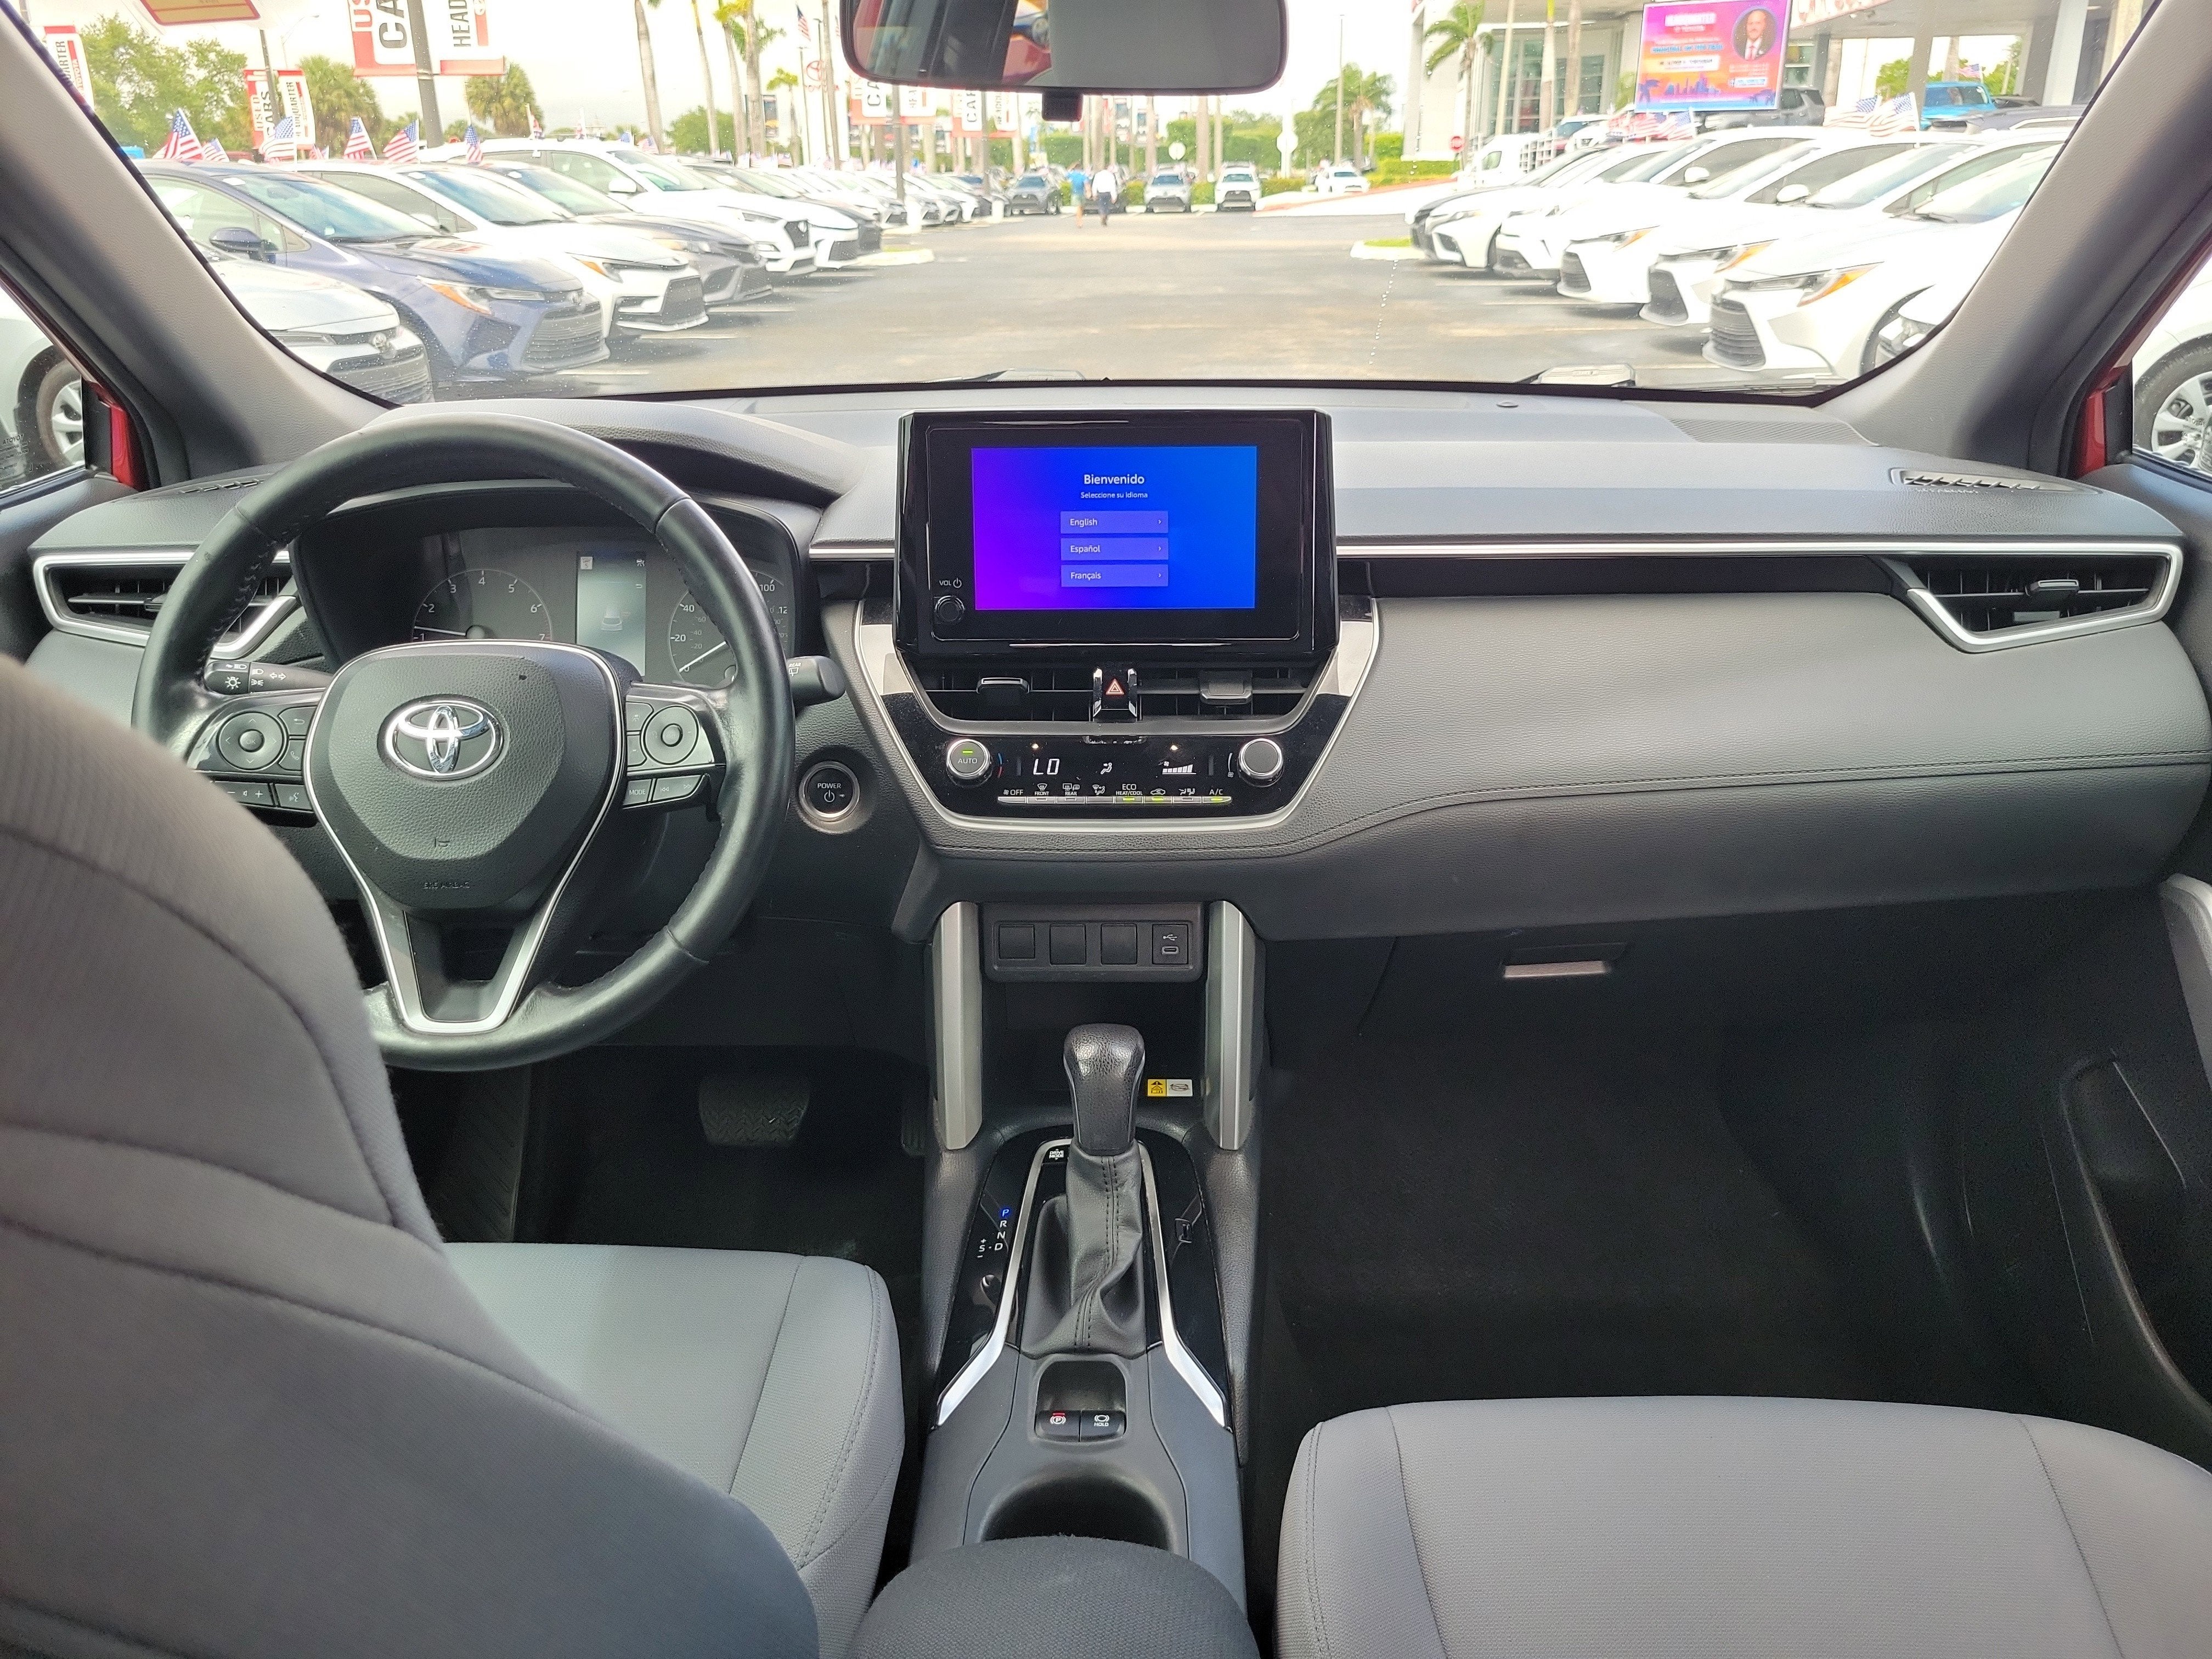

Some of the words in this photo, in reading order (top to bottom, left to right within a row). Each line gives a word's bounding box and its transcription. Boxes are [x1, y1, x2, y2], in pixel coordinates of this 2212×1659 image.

[1084, 473, 1145, 484] Bienvenido
[1070, 518, 1098, 528] English
[1070, 545, 1101, 554] Español
[478, 577, 486, 585] 4
[1070, 572, 1102, 581] Français
[450, 584, 456, 593] 3
[509, 584, 515, 592] 5
[759, 584, 775, 592] 100
[428, 603, 435, 613] 2
[531, 604, 538, 613] 6
[682, 605, 695, 613] 40
[1033, 758, 1060, 775] LO
[1002, 1209, 1009, 1217] P
[1000, 1220, 1008, 1228] R
[997, 1231, 1006, 1239] N
[978, 1244, 986, 1252] S
[994, 1243, 1003, 1251] D
